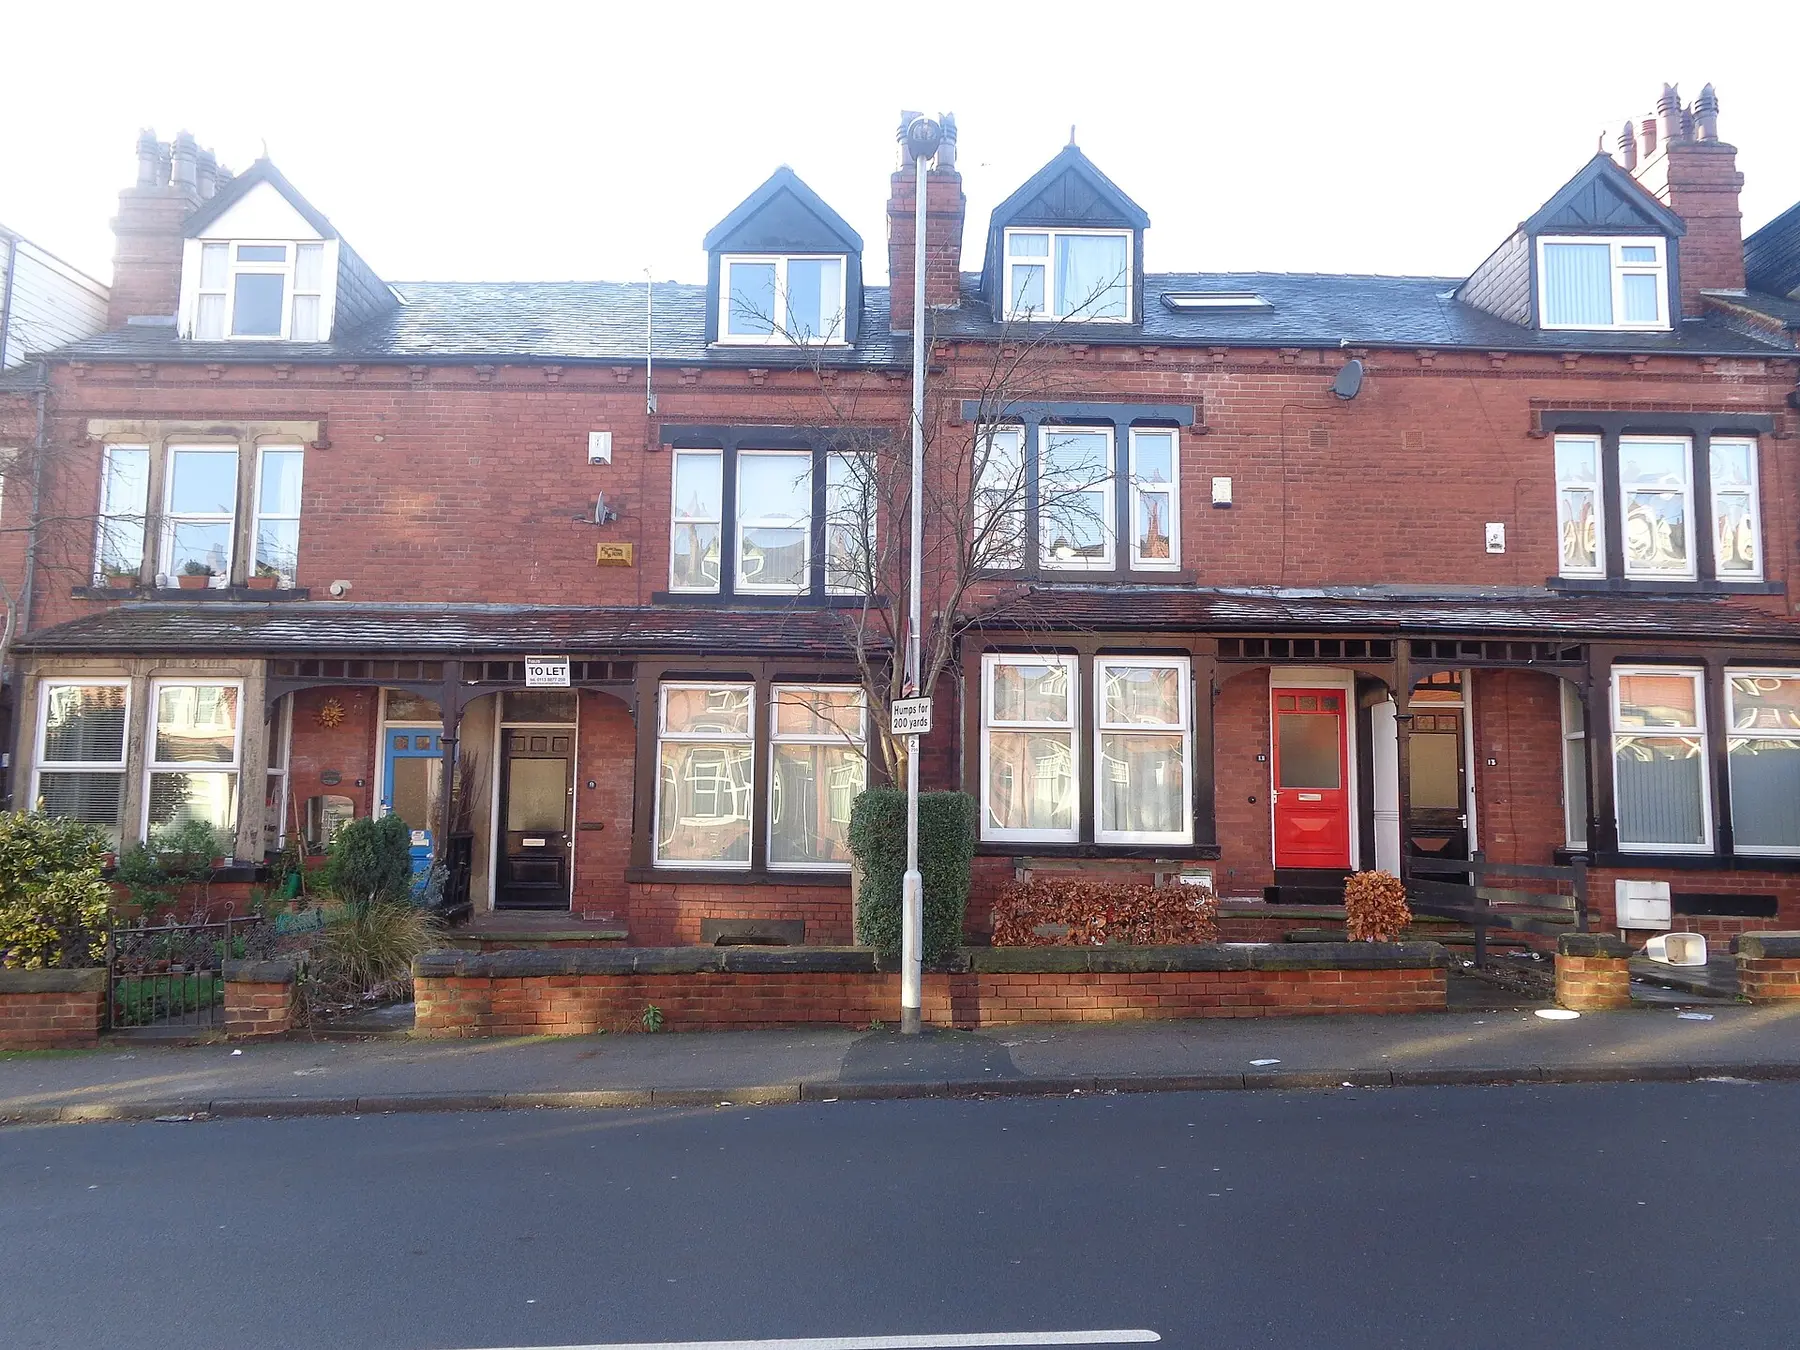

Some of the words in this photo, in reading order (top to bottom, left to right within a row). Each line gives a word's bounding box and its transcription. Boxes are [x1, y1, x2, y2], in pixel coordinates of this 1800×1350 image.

[529, 667, 543, 675] TO
[546, 667, 566, 675] LET
[894, 705, 917, 716] Humps
[918, 703, 928, 713] for
[894, 718, 908, 728] 200
[909, 717, 928, 729] yards
